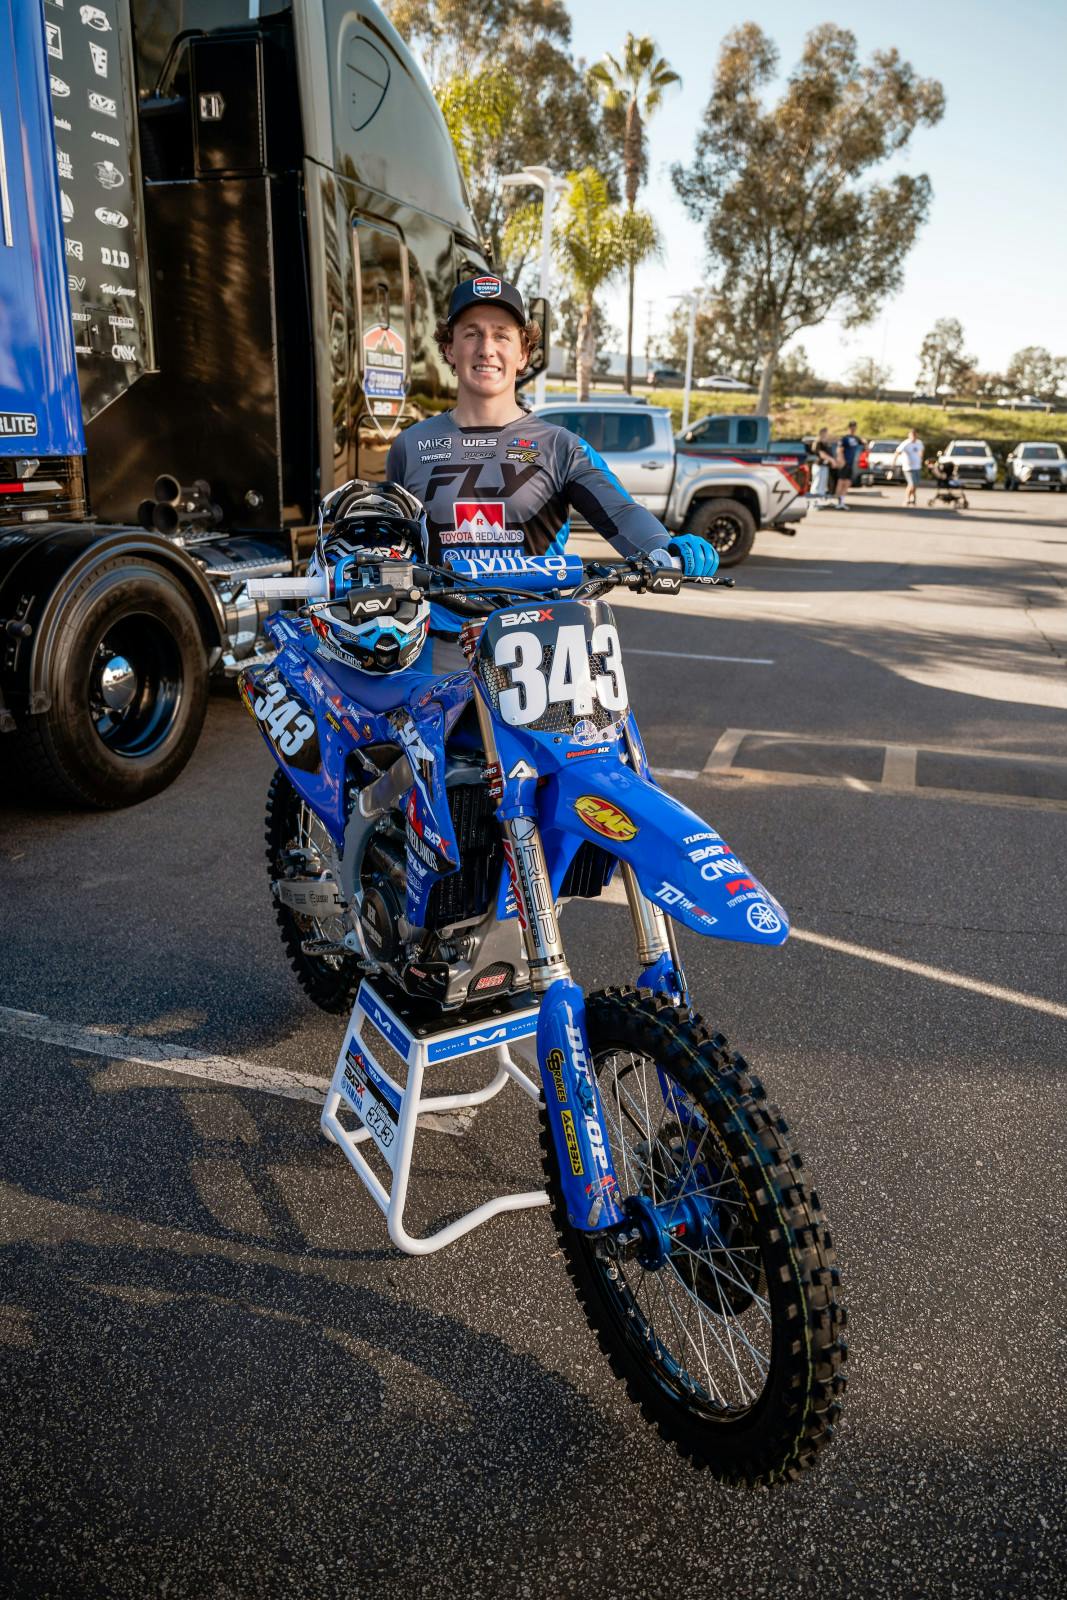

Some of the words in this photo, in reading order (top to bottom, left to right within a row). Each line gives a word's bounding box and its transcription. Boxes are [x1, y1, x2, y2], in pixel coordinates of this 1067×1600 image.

[462, 438, 498, 447] WPS
[424, 463, 543, 502] FLY
[440, 532, 473, 543] TOYOTA
[475, 531, 523, 542] REDLANDS
[460, 549, 521, 560] YAMAHA
[309, 602, 328, 612] ASV
[352, 597, 392, 615] ASV
[653, 578, 680, 588] ASV
[695, 576, 720, 585] ASV
[500, 608, 555, 627] BARX
[495, 624, 628, 725] 343
[255, 682, 315, 757] 343
[575, 797, 638, 836] FMF
[515, 847, 541, 948] SUSPENSION
[523, 844, 558, 945] REP
[679, 897, 719, 926] TWED
[435, 1041, 465, 1053] MATRIX
[344, 1064, 366, 1097] BARX
[345, 1080, 363, 1113] YAMAHA
[565, 1024, 609, 1169] DUOP
[366, 1106, 395, 1148] 343
[562, 1110, 584, 1175] ACERBIS
